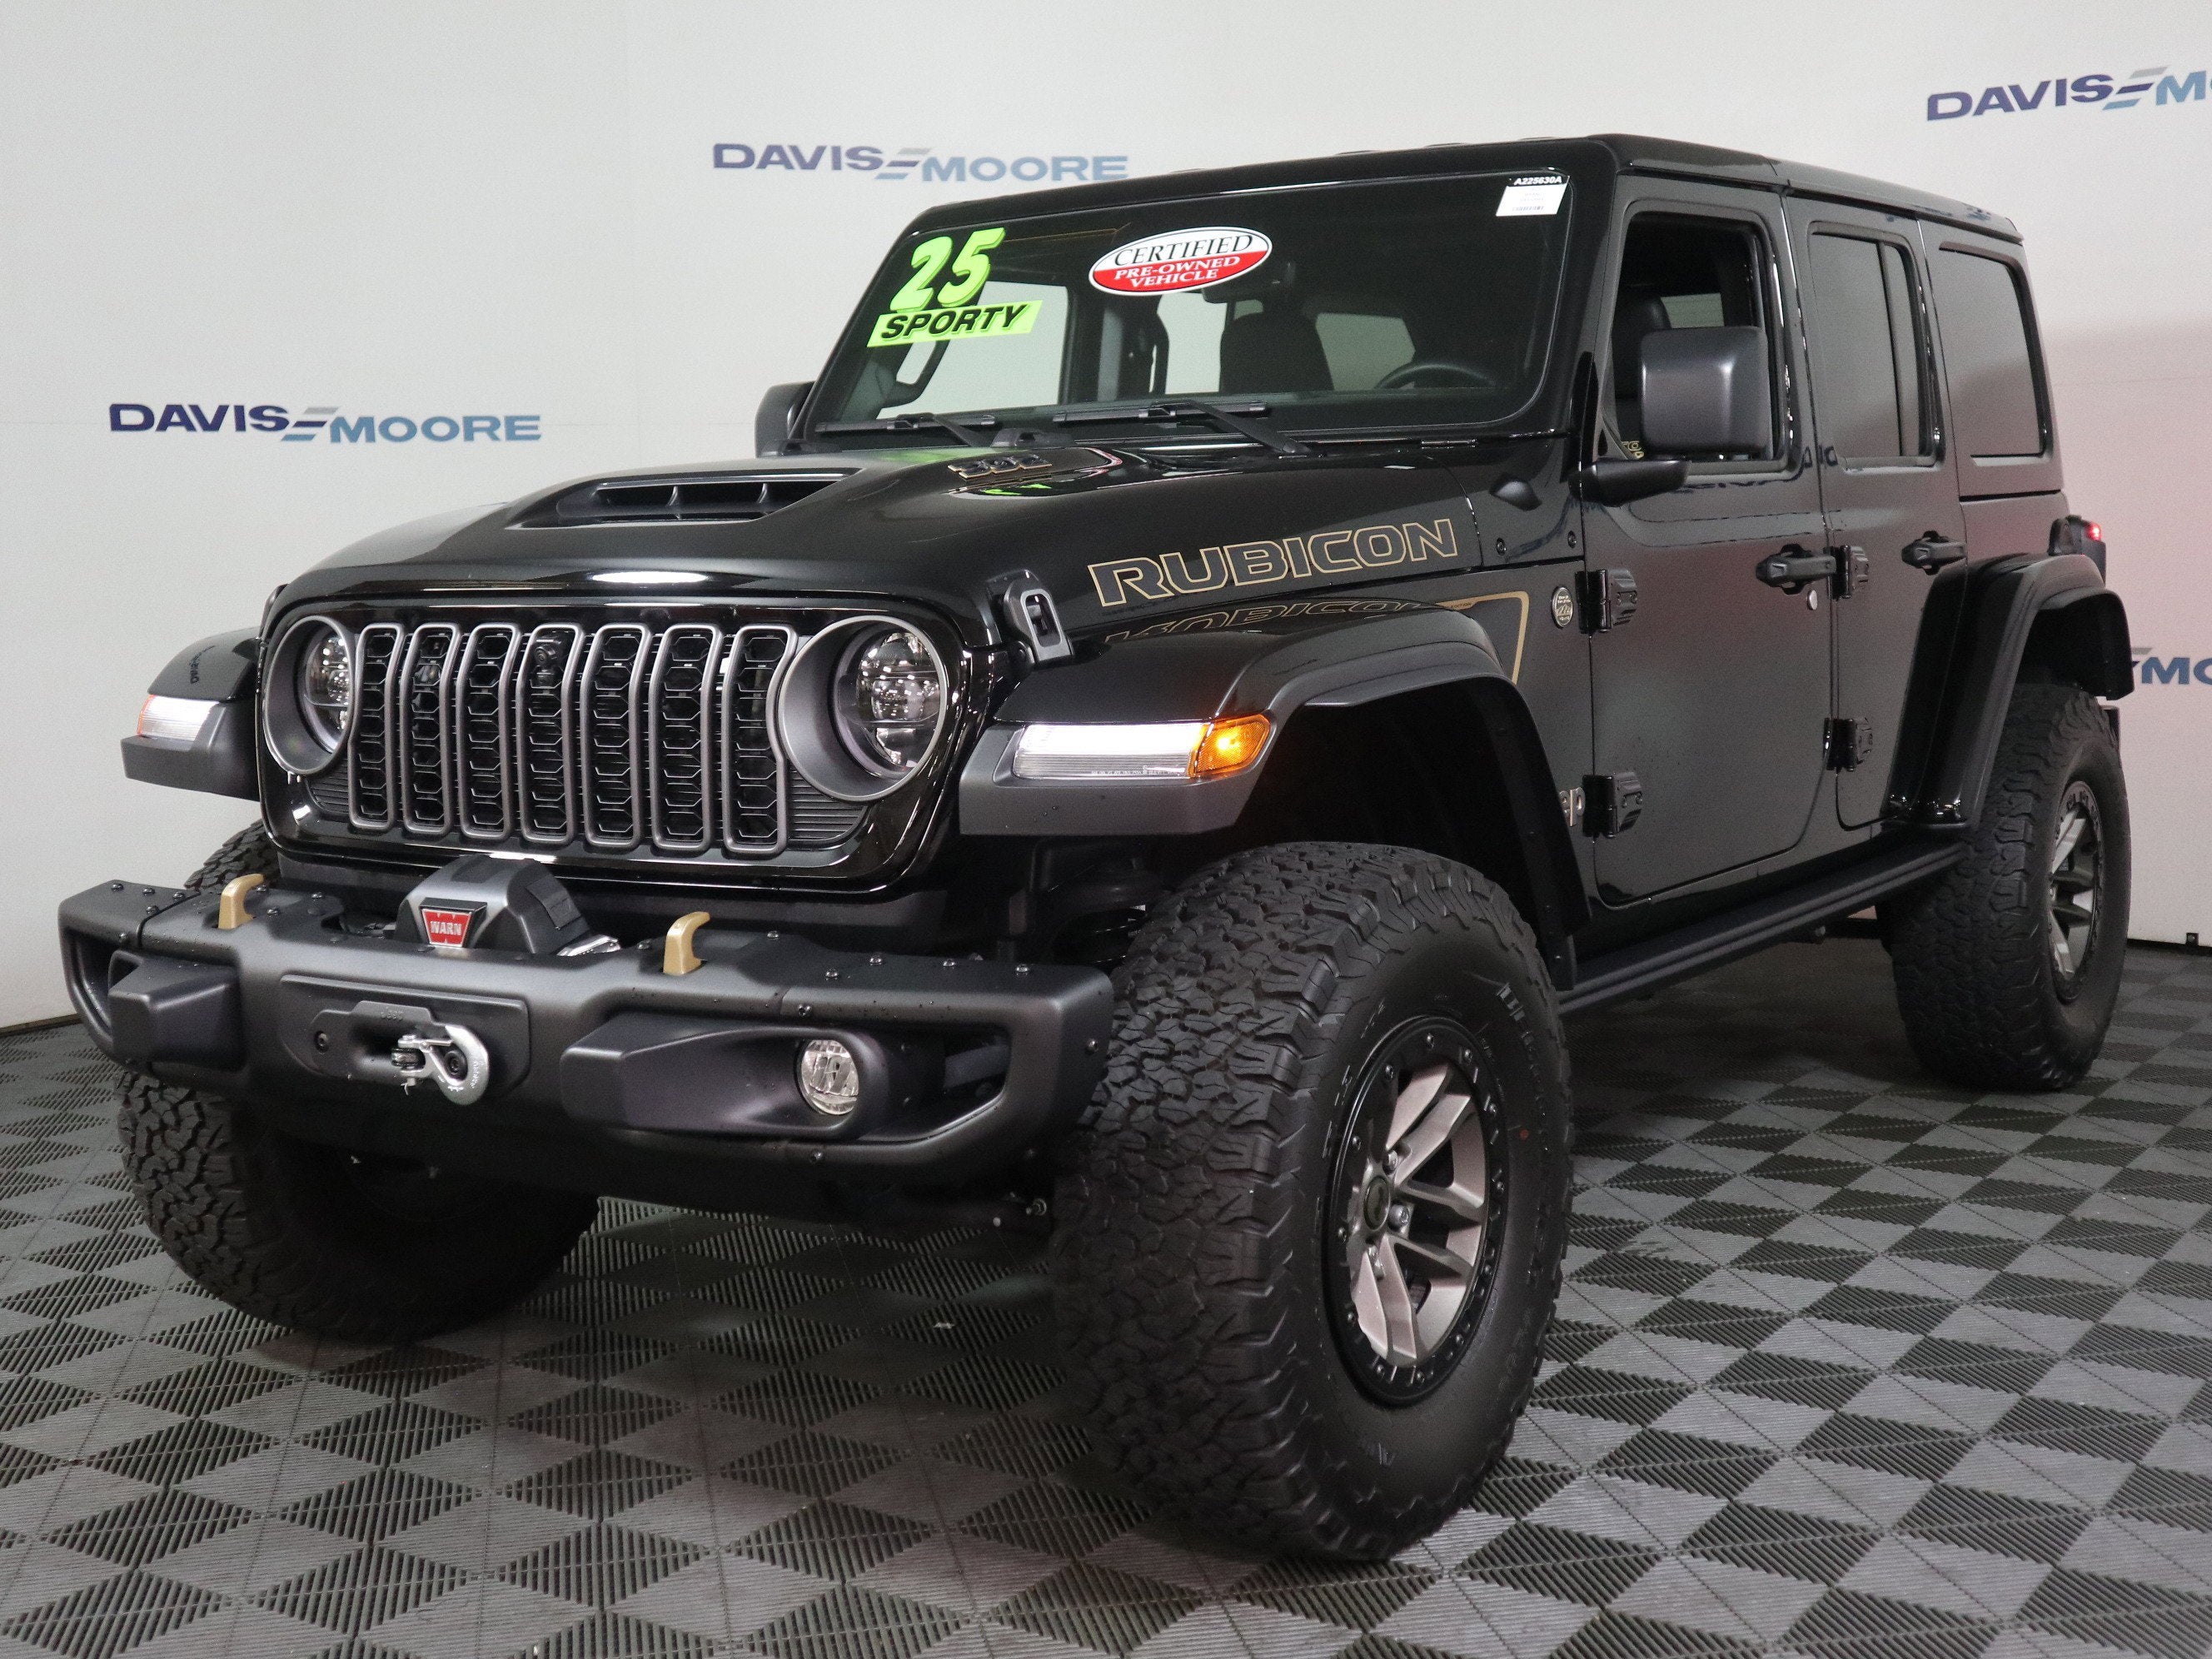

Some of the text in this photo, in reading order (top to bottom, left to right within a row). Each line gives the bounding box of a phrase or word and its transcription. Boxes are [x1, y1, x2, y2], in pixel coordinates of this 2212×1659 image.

[1927, 74, 2114, 121] DAVIS
[712, 143, 1128, 182] DAVIS MOORE
[890, 227, 1005, 311] 25
[1114, 235, 1253, 267] CERTIFIED
[1114, 257, 1240, 281] PRE-OWNED
[1130, 269, 1218, 288] VEHICLE
[880, 303, 1029, 341] SPORTY
[109, 404, 541, 443] DAVIS MOORE
[1088, 518, 1458, 607] RUBICON
[430, 920, 462, 936] WARN
